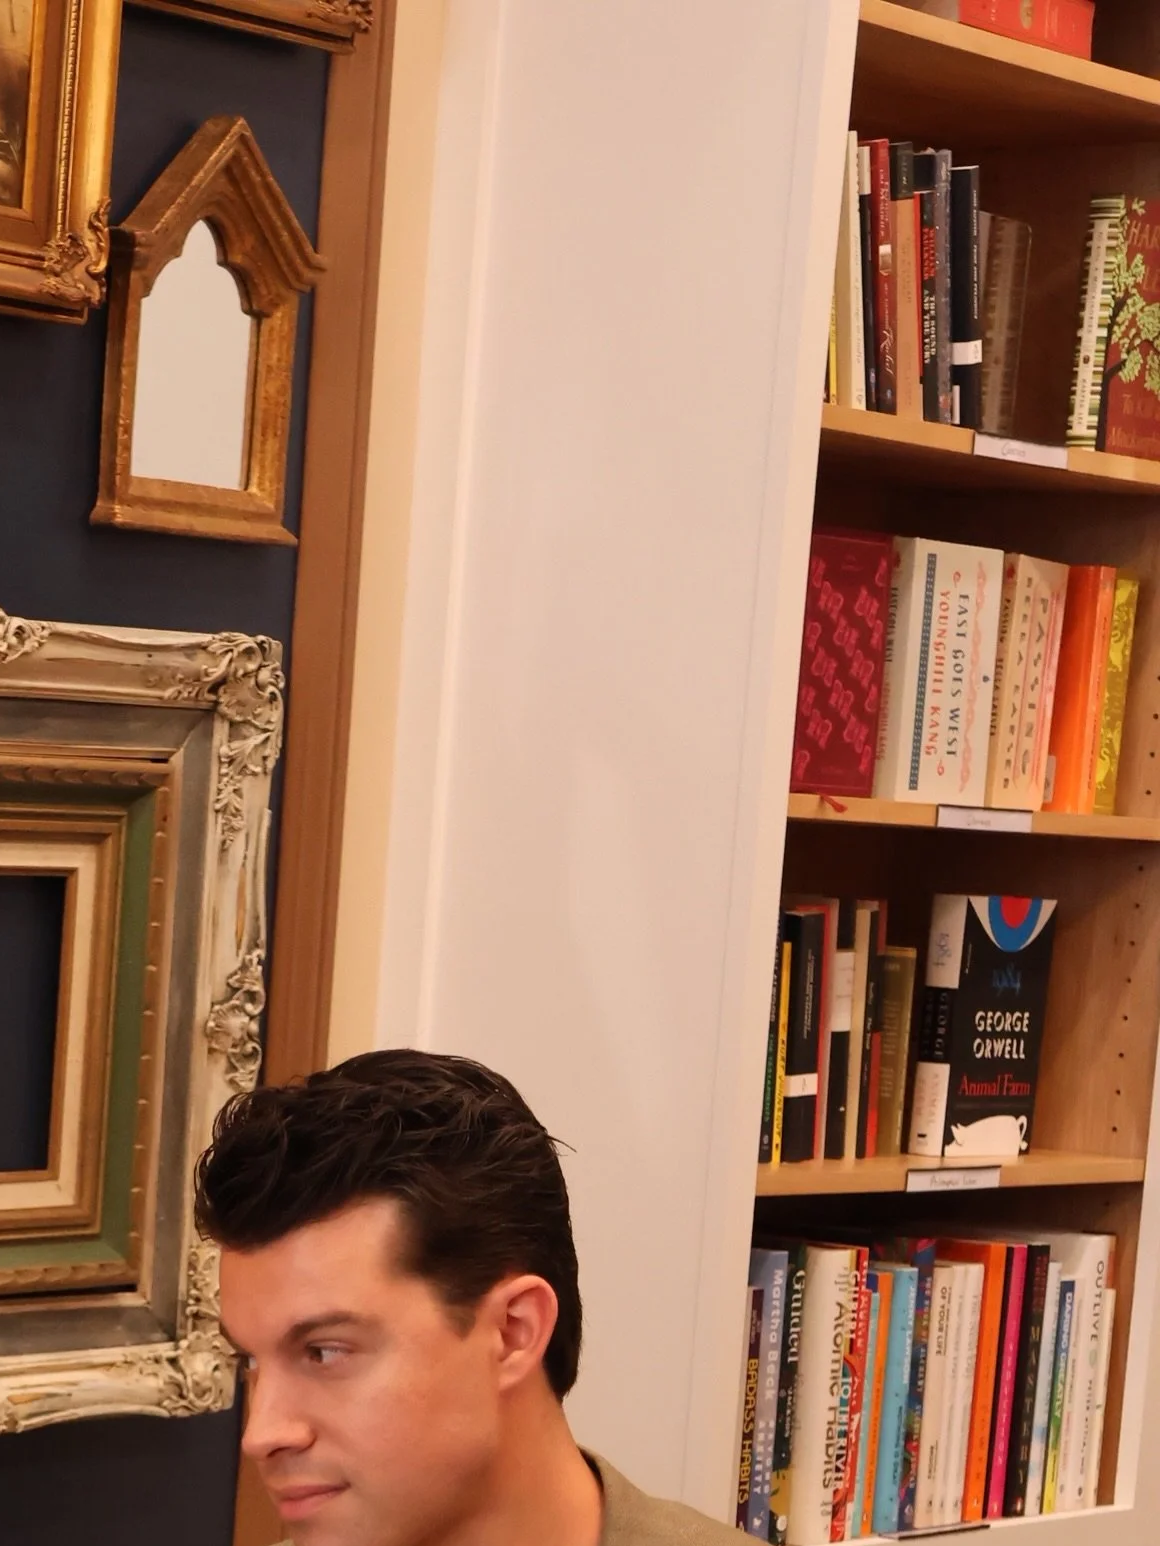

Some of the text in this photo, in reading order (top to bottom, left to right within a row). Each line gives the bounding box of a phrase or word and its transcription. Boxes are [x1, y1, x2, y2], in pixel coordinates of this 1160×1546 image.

[879, 327, 894, 375] Rachel
[923, 337, 931, 364] FURY
[925, 590, 951, 757] YOUNGHILL KANG
[945, 592, 970, 758] EAST GOES WEST
[1021, 597, 1048, 776] PASSING
[932, 932, 952, 968] 1984
[933, 992, 948, 1057] GEORGE
[972, 1037, 1026, 1060] ORWELL
[974, 1010, 1030, 1033] GEORGE
[957, 1072, 1031, 1097] Animal Farm
[764, 1269, 784, 1401] Martha Beck
[935, 1286, 948, 1356] OF YOUR LIFE
[1090, 1260, 1105, 1342] OUTLIVE
[840, 1376, 852, 1399] TO
[902, 1329, 913, 1385] LAWSON
[1054, 1291, 1073, 1418] DARING GREATLY
[743, 1357, 760, 1434] BADASS
[822, 1301, 844, 1490] Atomic Habits
[1019, 1325, 1041, 1485] MASTERY
[737, 1439, 753, 1505] HABITS
